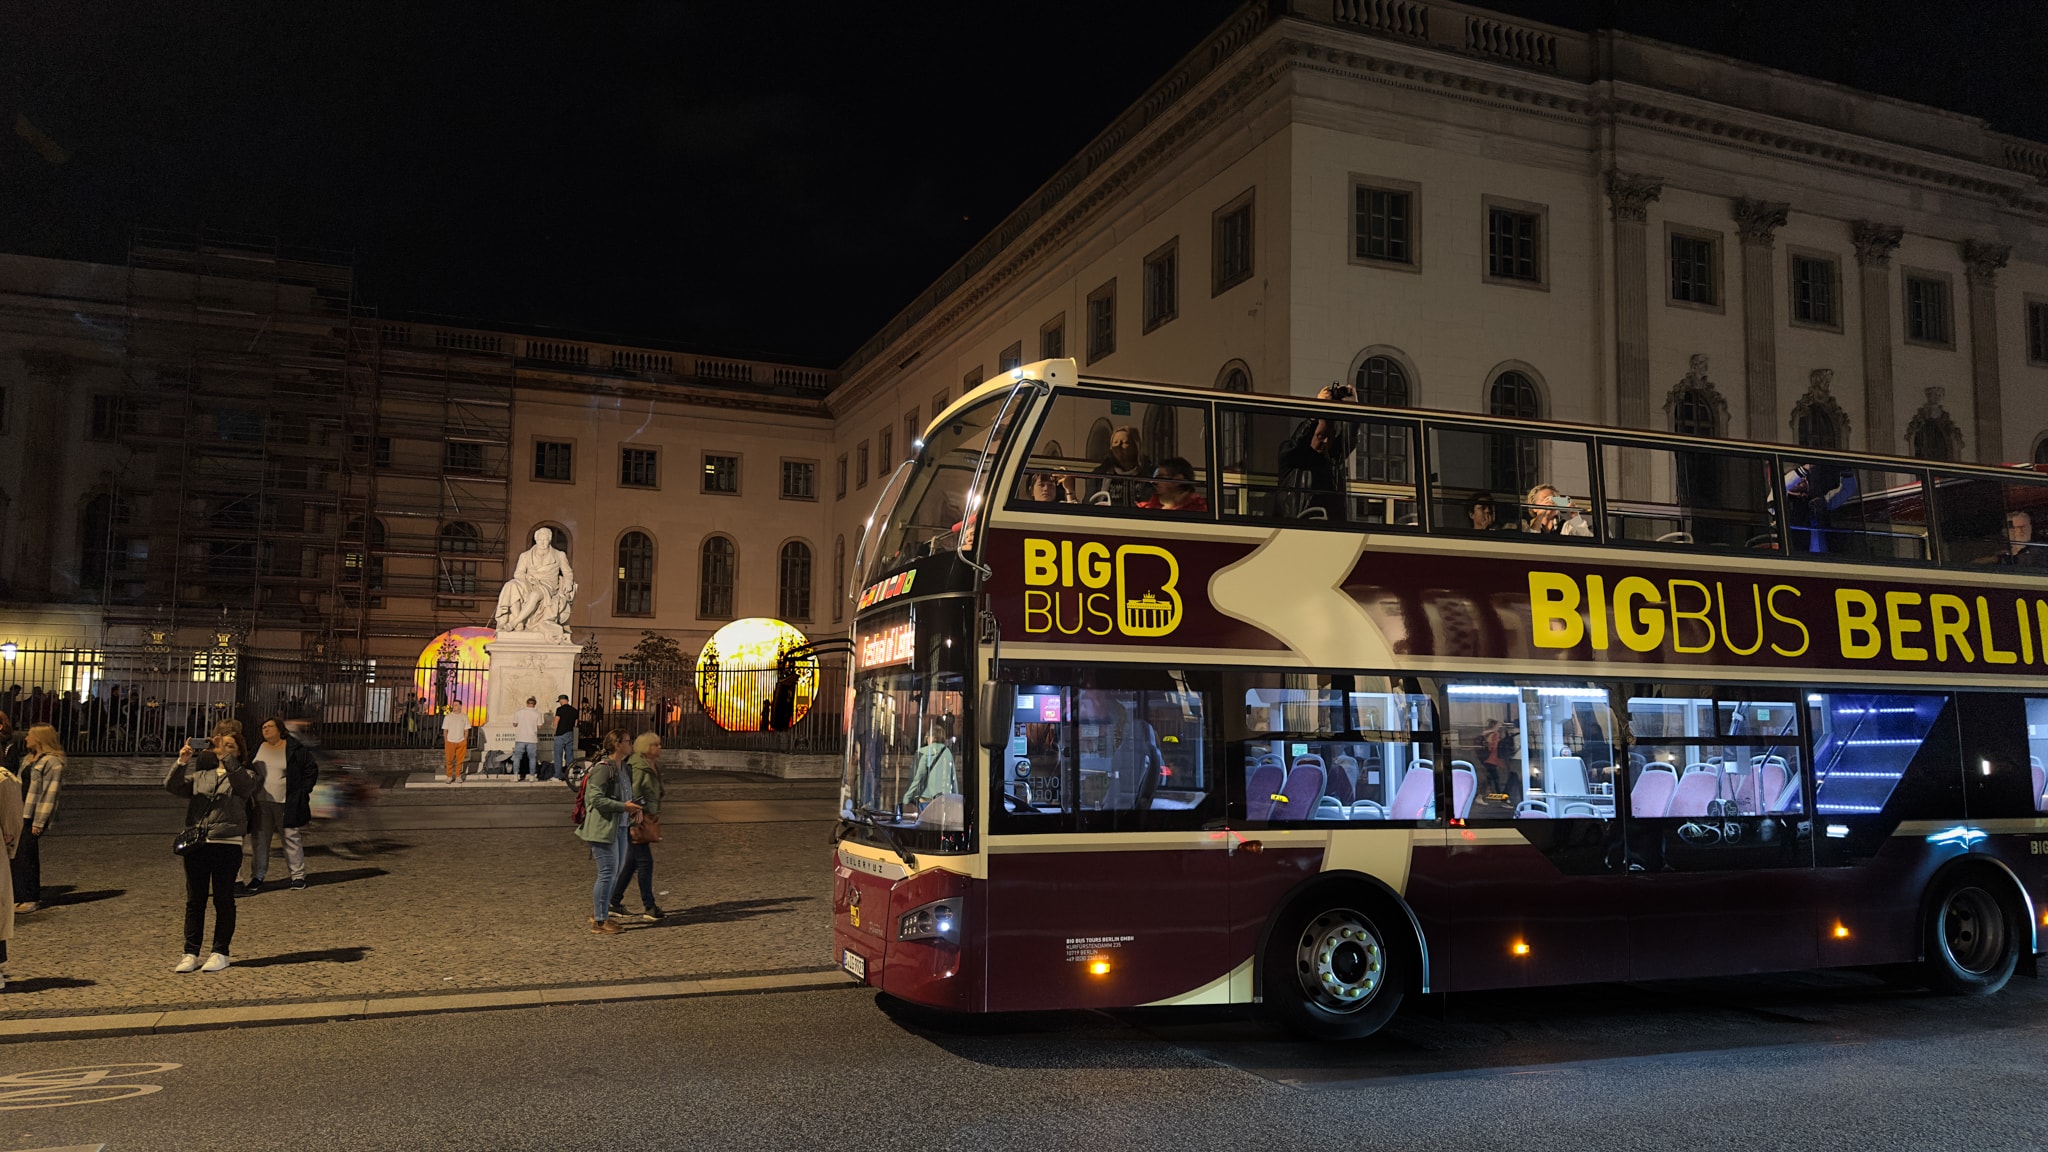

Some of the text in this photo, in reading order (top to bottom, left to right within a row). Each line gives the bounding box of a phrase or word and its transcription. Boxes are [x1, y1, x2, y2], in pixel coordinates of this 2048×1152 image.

[1024, 538, 1111, 588] BIG
[1024, 590, 1113, 635] BUS
[1835, 588, 2048, 665] BERLI
